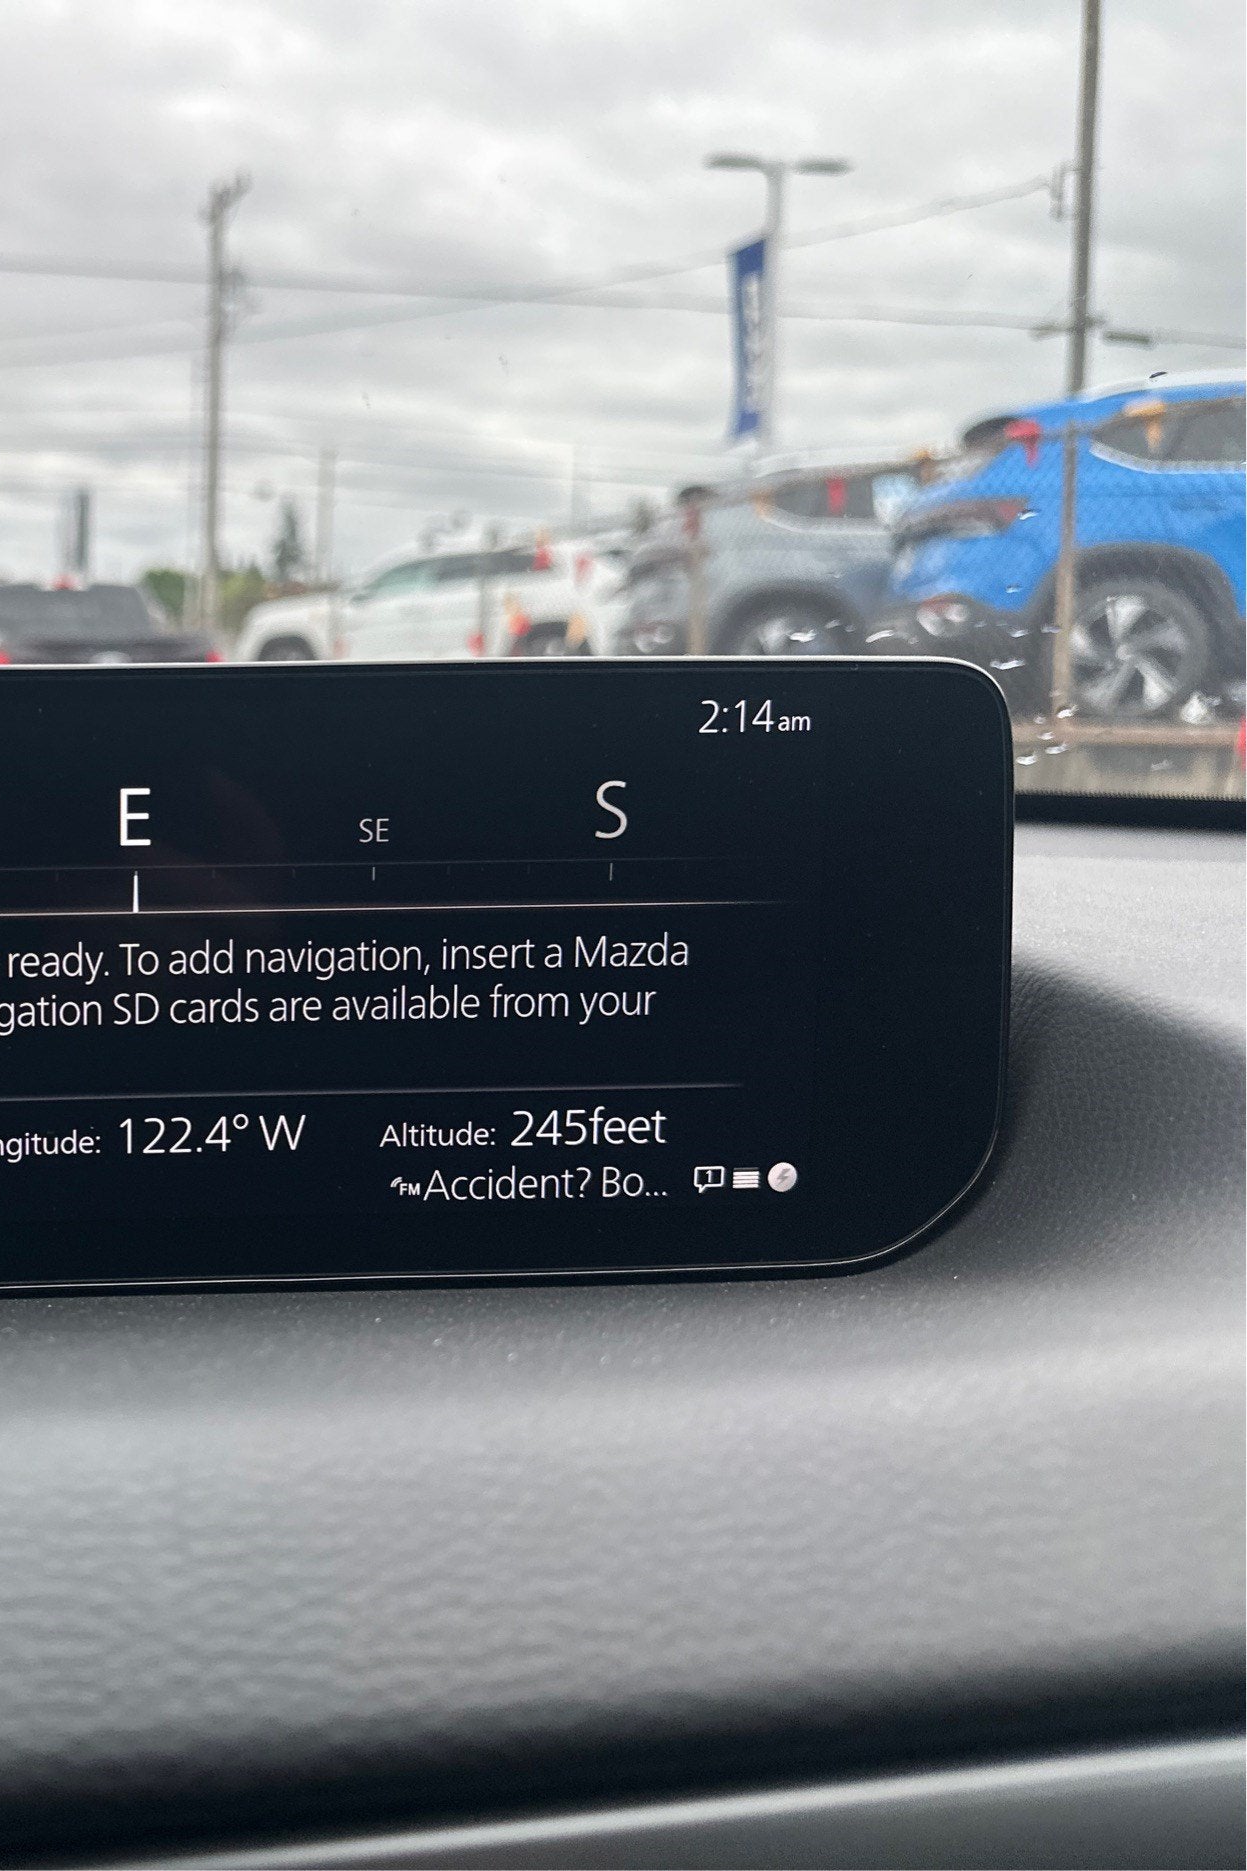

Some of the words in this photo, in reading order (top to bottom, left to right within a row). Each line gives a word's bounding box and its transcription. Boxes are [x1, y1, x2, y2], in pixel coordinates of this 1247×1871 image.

[698, 698, 811, 735] 2:14am
[119, 787, 152, 847] E
[359, 818, 390, 843] SE
[594, 780, 628, 839] S
[8, 941, 110, 986] ready.
[118, 943, 160, 976] To
[168, 938, 234, 975] add
[246, 939, 430, 981] navigation,
[442, 938, 536, 971] insert
[544, 943, 563, 969] a
[574, 931, 689, 968] Mazda
[113, 992, 160, 1026] SD
[169, 987, 260, 1024] cards
[269, 996, 323, 1022] are
[332, 984, 481, 1021] available
[489, 983, 569, 1018] from
[578, 990, 657, 1026] your
[379, 1120, 496, 1148] Altitude:
[510, 1105, 668, 1147] 245feet
[399, 1182, 421, 1196] FM
[422, 1164, 592, 1201] Accident?
[602, 1166, 668, 1198] Bo...
